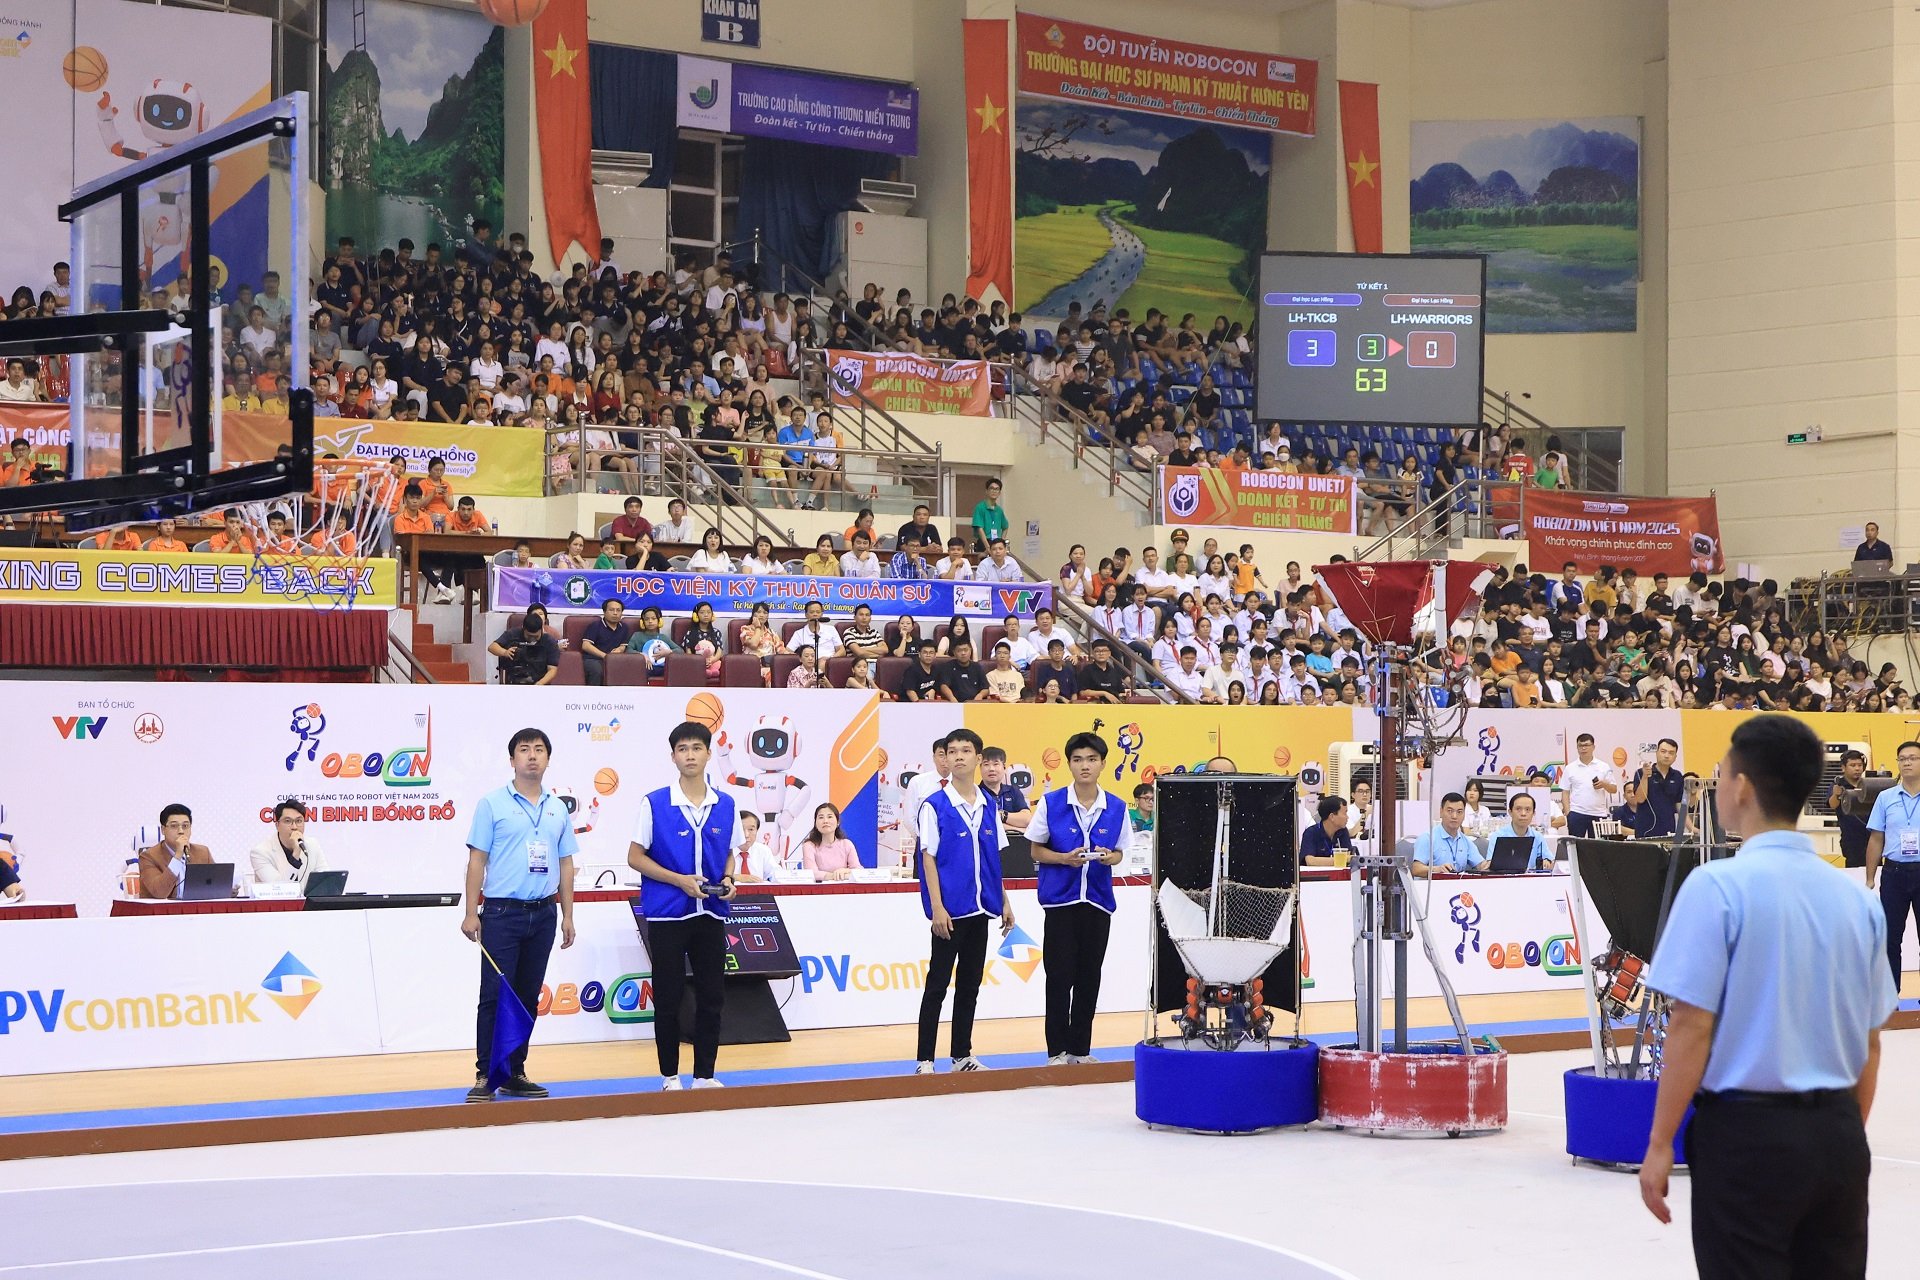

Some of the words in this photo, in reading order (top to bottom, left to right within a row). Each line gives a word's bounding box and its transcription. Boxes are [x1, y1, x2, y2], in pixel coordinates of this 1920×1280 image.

[717, 20, 744, 42] B
[1084, 34, 1115, 57] ĐỘI
[1120, 39, 1170, 63] TUYỂN
[1173, 52, 1258, 78] ROBOCON
[1027, 50, 1078, 76] TRƯỜNG
[1080, 60, 1102, 84] ĐẠI
[1105, 64, 1131, 89] HỌC
[1135, 70, 1153, 89] SƯ
[1154, 72, 1190, 97] PHẠM
[1193, 75, 1210, 97] KỸ
[1212, 79, 1249, 105] THUẬT
[1251, 86, 1285, 109] HƯNG
[1287, 90, 1309, 111] YÊN
[1060, 82, 1089, 97] Đoàn
[738, 91, 769, 110] TRƯỜNG
[771, 97, 787, 112] CAO
[811, 100, 832, 118] CÔNG
[833, 105, 863, 123] THƯƠNG
[865, 107, 885, 125] MIỀN
[886, 112, 911, 129] TRUNG
[754, 113, 781, 126] Đoàn
[782, 113, 798, 129] kết
[805, 119, 817, 134] Tự
[818, 121, 831, 134] tin
[838, 123, 865, 138] Chiến
[1357, 282, 1368, 290] TỨ
[1369, 282, 1383, 290] KẾT
[1288, 313, 1338, 324] LH-TKCB
[1390, 313, 1473, 325] LH-WARRIORS
[1306, 339, 1318, 357] 3
[1366, 339, 1377, 356] 3
[1425, 340, 1438, 359] 0
[875, 359, 938, 380] ROBOCON
[1355, 368, 1387, 392] 63
[885, 393, 921, 413] CHIẾN
[22, 425, 72, 447] CÔNG
[356, 444, 379, 457] ĐẠI
[412, 448, 437, 461] LẠC
[439, 446, 476, 462] HỒNG
[1241, 472, 1304, 490] ROBOCON
[1308, 477, 1345, 494] UNETI
[1237, 490, 1273, 508] ĐOÀN
[1275, 490, 1299, 509] KẾT
[1308, 495, 1328, 512] TỰ
[1329, 498, 1347, 513] TIN
[1252, 508, 1290, 528] CHIẾN
[1533, 515, 1592, 532] ROBOCON
[1592, 517, 1617, 536] VIỆT
[1619, 521, 1646, 534] NAM
[1646, 522, 1681, 535] 2025
[1545, 535, 1565, 547] Khát
[1566, 538, 1587, 550] vọng
[1613, 539, 1635, 551] phục
[1656, 541, 1673, 550] cao
[97, 562, 247, 594] COMES
[260, 565, 375, 595] BACK
[616, 576, 665, 598] HỌC
[670, 575, 721, 599] VIỆN
[728, 577, 757, 598] KỸ
[764, 578, 834, 602] THUẬT
[838, 581, 897, 601] QUÂN
[902, 583, 932, 605] SỰ
[999, 590, 1044, 613] VTV
[78, 701, 95, 709] BAN
[98, 698, 109, 709] TỔ
[111, 700, 135, 709] CHỨC
[52, 716, 109, 739] VTV
[316, 793, 337, 801] SÁNG
[338, 794, 355, 803] TẠO
[384, 793, 402, 801] VIỆT
[422, 792, 440, 800] 2025
[322, 806, 368, 822] BINH
[372, 802, 425, 822] BÓNG
[429, 800, 456, 821] RỔ
[724, 916, 779, 924] LH-WARRIORS
[753, 934, 765, 947] 0
[724, 953, 740, 970] 3
[0, 989, 263, 1035] PVcomBank
